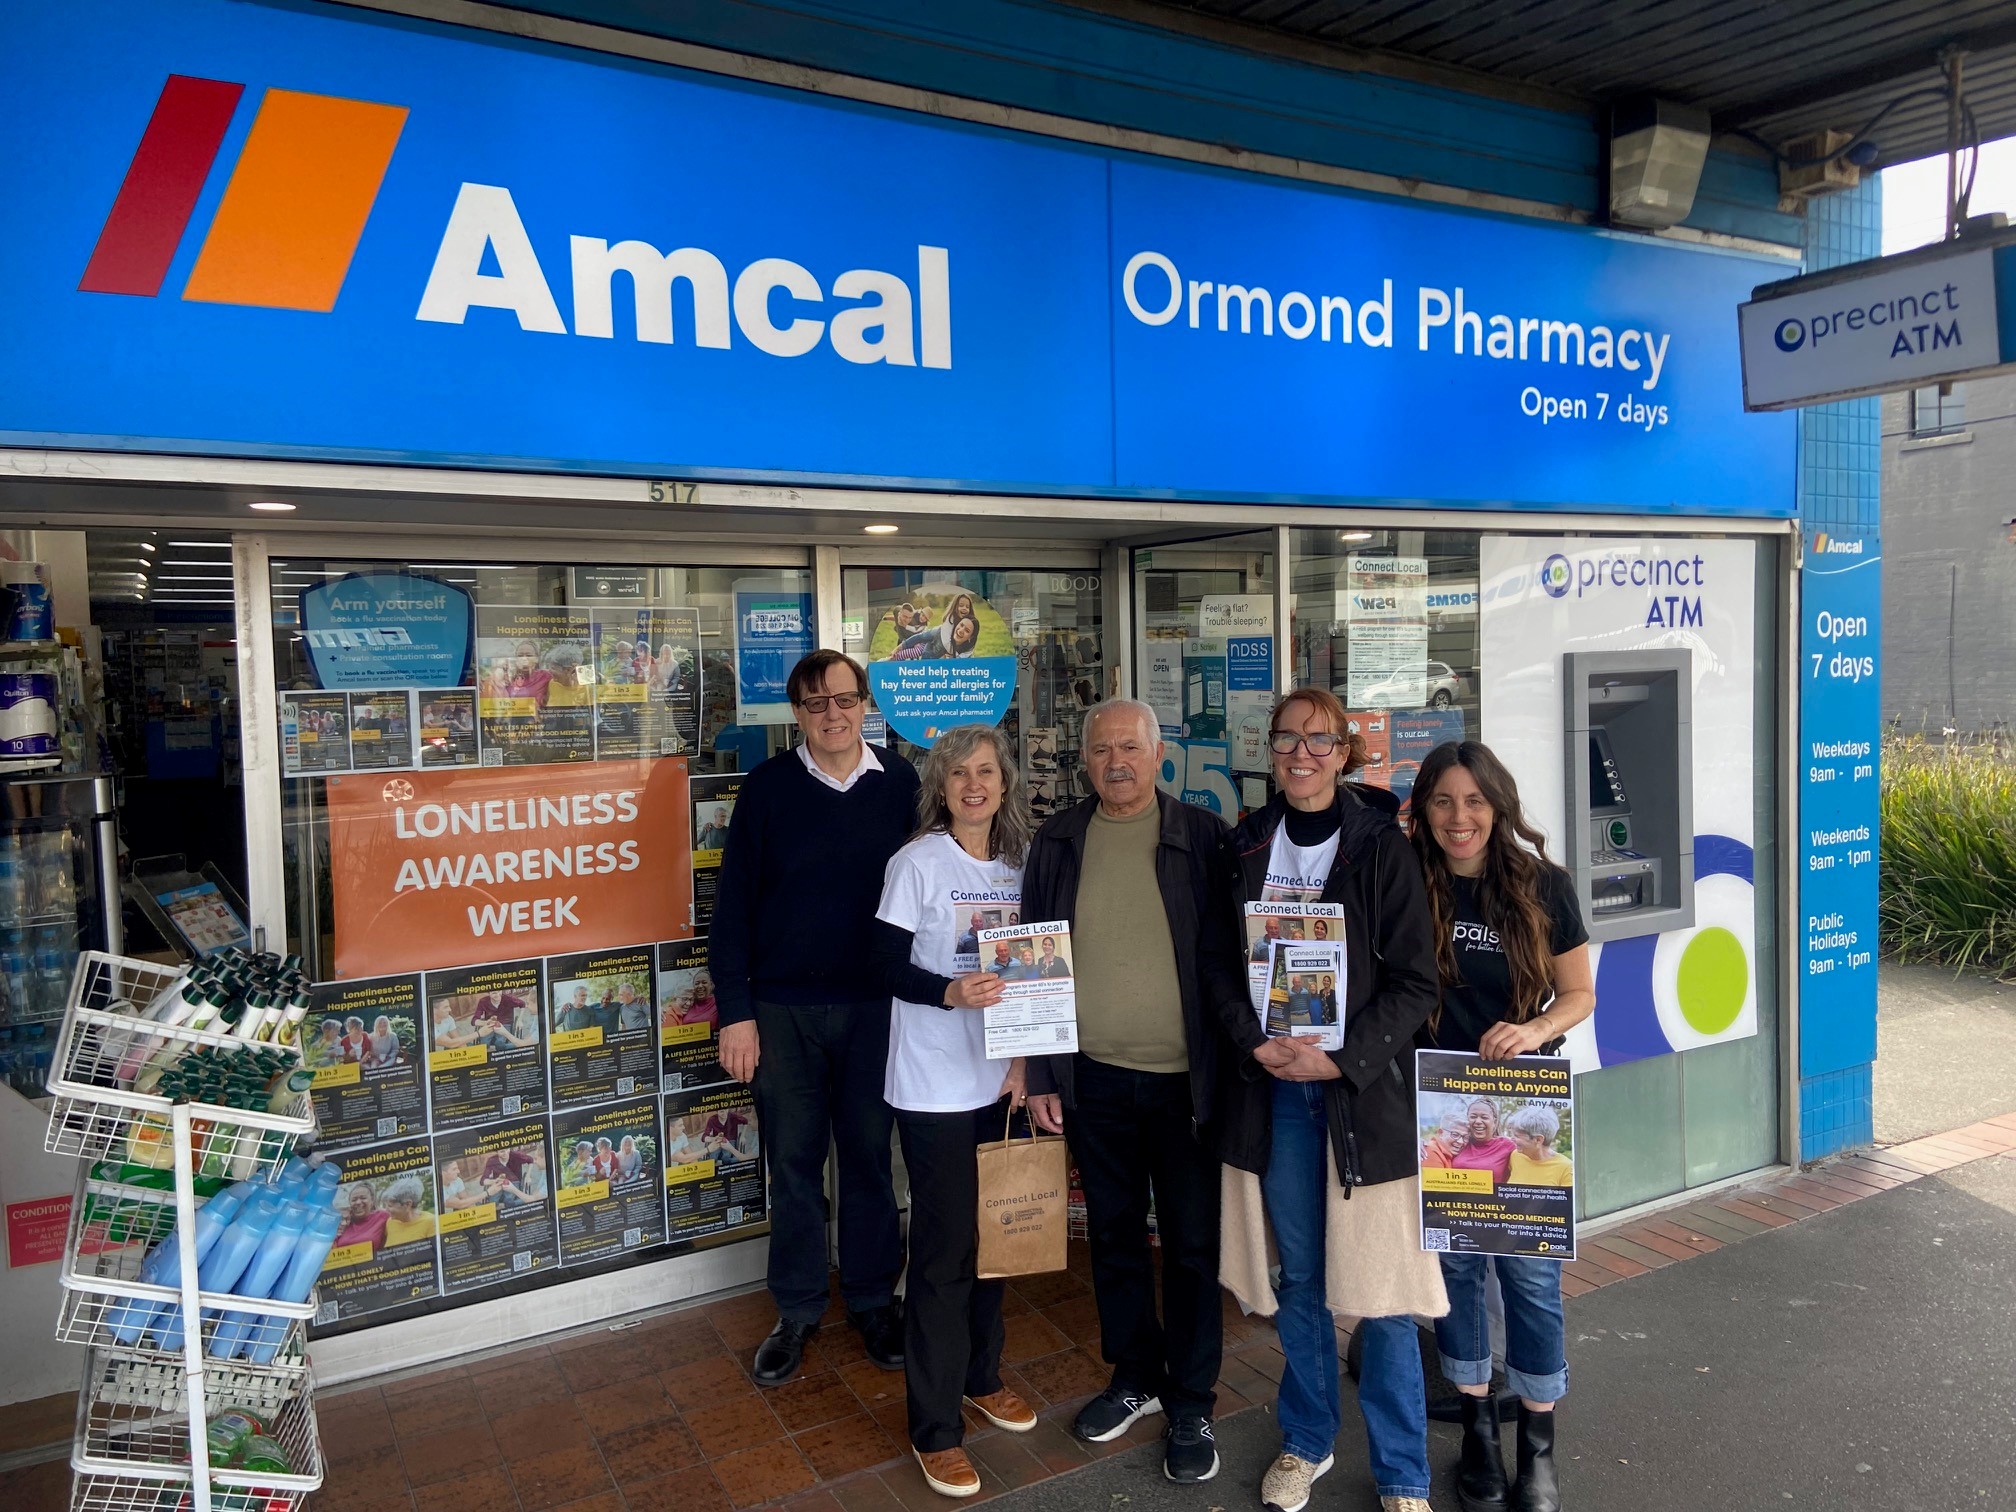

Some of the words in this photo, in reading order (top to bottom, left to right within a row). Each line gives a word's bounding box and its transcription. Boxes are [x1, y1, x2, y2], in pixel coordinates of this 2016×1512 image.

[416, 182, 952, 370] Amcal
[1123, 250, 1394, 349] Ormond
[1418, 287, 1671, 390] Pharmacy
[1811, 281, 1960, 349] precinct
[1890, 318, 1962, 360] ATM
[1521, 388, 1587, 422] Open
[1596, 393, 1609, 420] 7
[1617, 393, 1668, 427] days
[650, 481, 698, 504] 517
[1828, 539, 1862, 554] Amcal
[1355, 561, 1394, 572] Connect
[1398, 563, 1422, 573] Local
[1578, 554, 1704, 598] precinct
[1052, 576, 1102, 592] BOOD
[331, 597, 368, 611] Arm
[376, 596, 446, 614] yourself
[1645, 597, 1703, 628] ATM
[514, 615, 566, 624] Loneliness
[1205, 616, 1231, 626] Trouble
[1234, 616, 1267, 626] sleeping?
[1817, 611, 1867, 643] Open
[497, 626, 536, 636] Happen
[539, 627, 550, 635] to
[552, 626, 588, 636] Anyone
[899, 667, 925, 676] Need
[928, 667, 949, 678] help
[952, 667, 989, 678] treating
[1154, 664, 1169, 672] OPEN
[1812, 654, 1822, 677] 7
[1830, 654, 1873, 683] days
[4, 689, 29, 697] Quilton
[882, 679, 899, 691] hay
[901, 680, 927, 689] fever
[930, 680, 947, 689] and
[951, 680, 989, 690] allergies
[993, 679, 1006, 688] for
[894, 694, 912, 704] you
[915, 693, 933, 702] and
[936, 694, 958, 704] your
[961, 692, 994, 703] family?
[1243, 726, 1259, 734] Think
[1423, 719, 1443, 727] lonely
[12, 741, 23, 750] 10
[1244, 737, 1259, 746] local
[1406, 740, 1433, 748] connect
[1812, 740, 1870, 758] Weekdays
[1810, 765, 1835, 782] 9am
[1854, 763, 1872, 782] pm
[1184, 793, 1209, 806] YEARS
[395, 791, 638, 839] LONELINESS
[1811, 826, 1869, 846] Weekends
[394, 840, 641, 892] AWARENESS
[1809, 853, 1835, 871] 9am
[1847, 850, 1871, 868] 1pm
[467, 895, 581, 937] WEEK
[1254, 904, 1301, 914] Connect
[1306, 905, 1336, 916] Local
[984, 925, 1030, 940] Connect
[1033, 922, 1063, 934] Local
[1455, 921, 1484, 929] pharmacy
[1809, 914, 1843, 933] Public
[1453, 926, 1499, 943] pals
[1809, 931, 1857, 952] Holidays
[1809, 957, 1835, 974] 9am
[1847, 950, 1870, 970] 1pm
[343, 985, 392, 1000] Loneliness
[394, 983, 413, 992] Can
[327, 1000, 366, 1012] Happen
[378, 993, 414, 1005] Anyone
[1466, 1065, 1536, 1079] Loneliness
[1539, 1069, 1567, 1080] Can
[1444, 1077, 1496, 1093] Happen
[1499, 1081, 1512, 1091] to
[1515, 1082, 1568, 1095] Anyone
[594, 1108, 636, 1123] Loneliness
[637, 1104, 653, 1114] Can
[1528, 1099, 1546, 1109] Any
[1549, 1101, 1568, 1110] Age
[581, 1121, 612, 1134] Happen
[624, 1113, 654, 1127] Anyone
[479, 1126, 523, 1143] Loneliness
[525, 1123, 543, 1134] Can
[464, 1142, 499, 1157] Happen
[500, 1140, 511, 1149] to
[512, 1131, 544, 1148] Anyone
[346, 1148, 405, 1168] Loneliness
[407, 1143, 429, 1158] Can
[985, 1195, 1028, 1208] Connect
[1031, 1189, 1058, 1201] Local
[1518, 1187, 1565, 1195] connectedness
[1500, 1213, 1524, 1221] GOOD
[1501, 1222, 1543, 1231] Pharmacist
[1545, 1225, 1567, 1233] Today
[1542, 1231, 1567, 1239] advice
